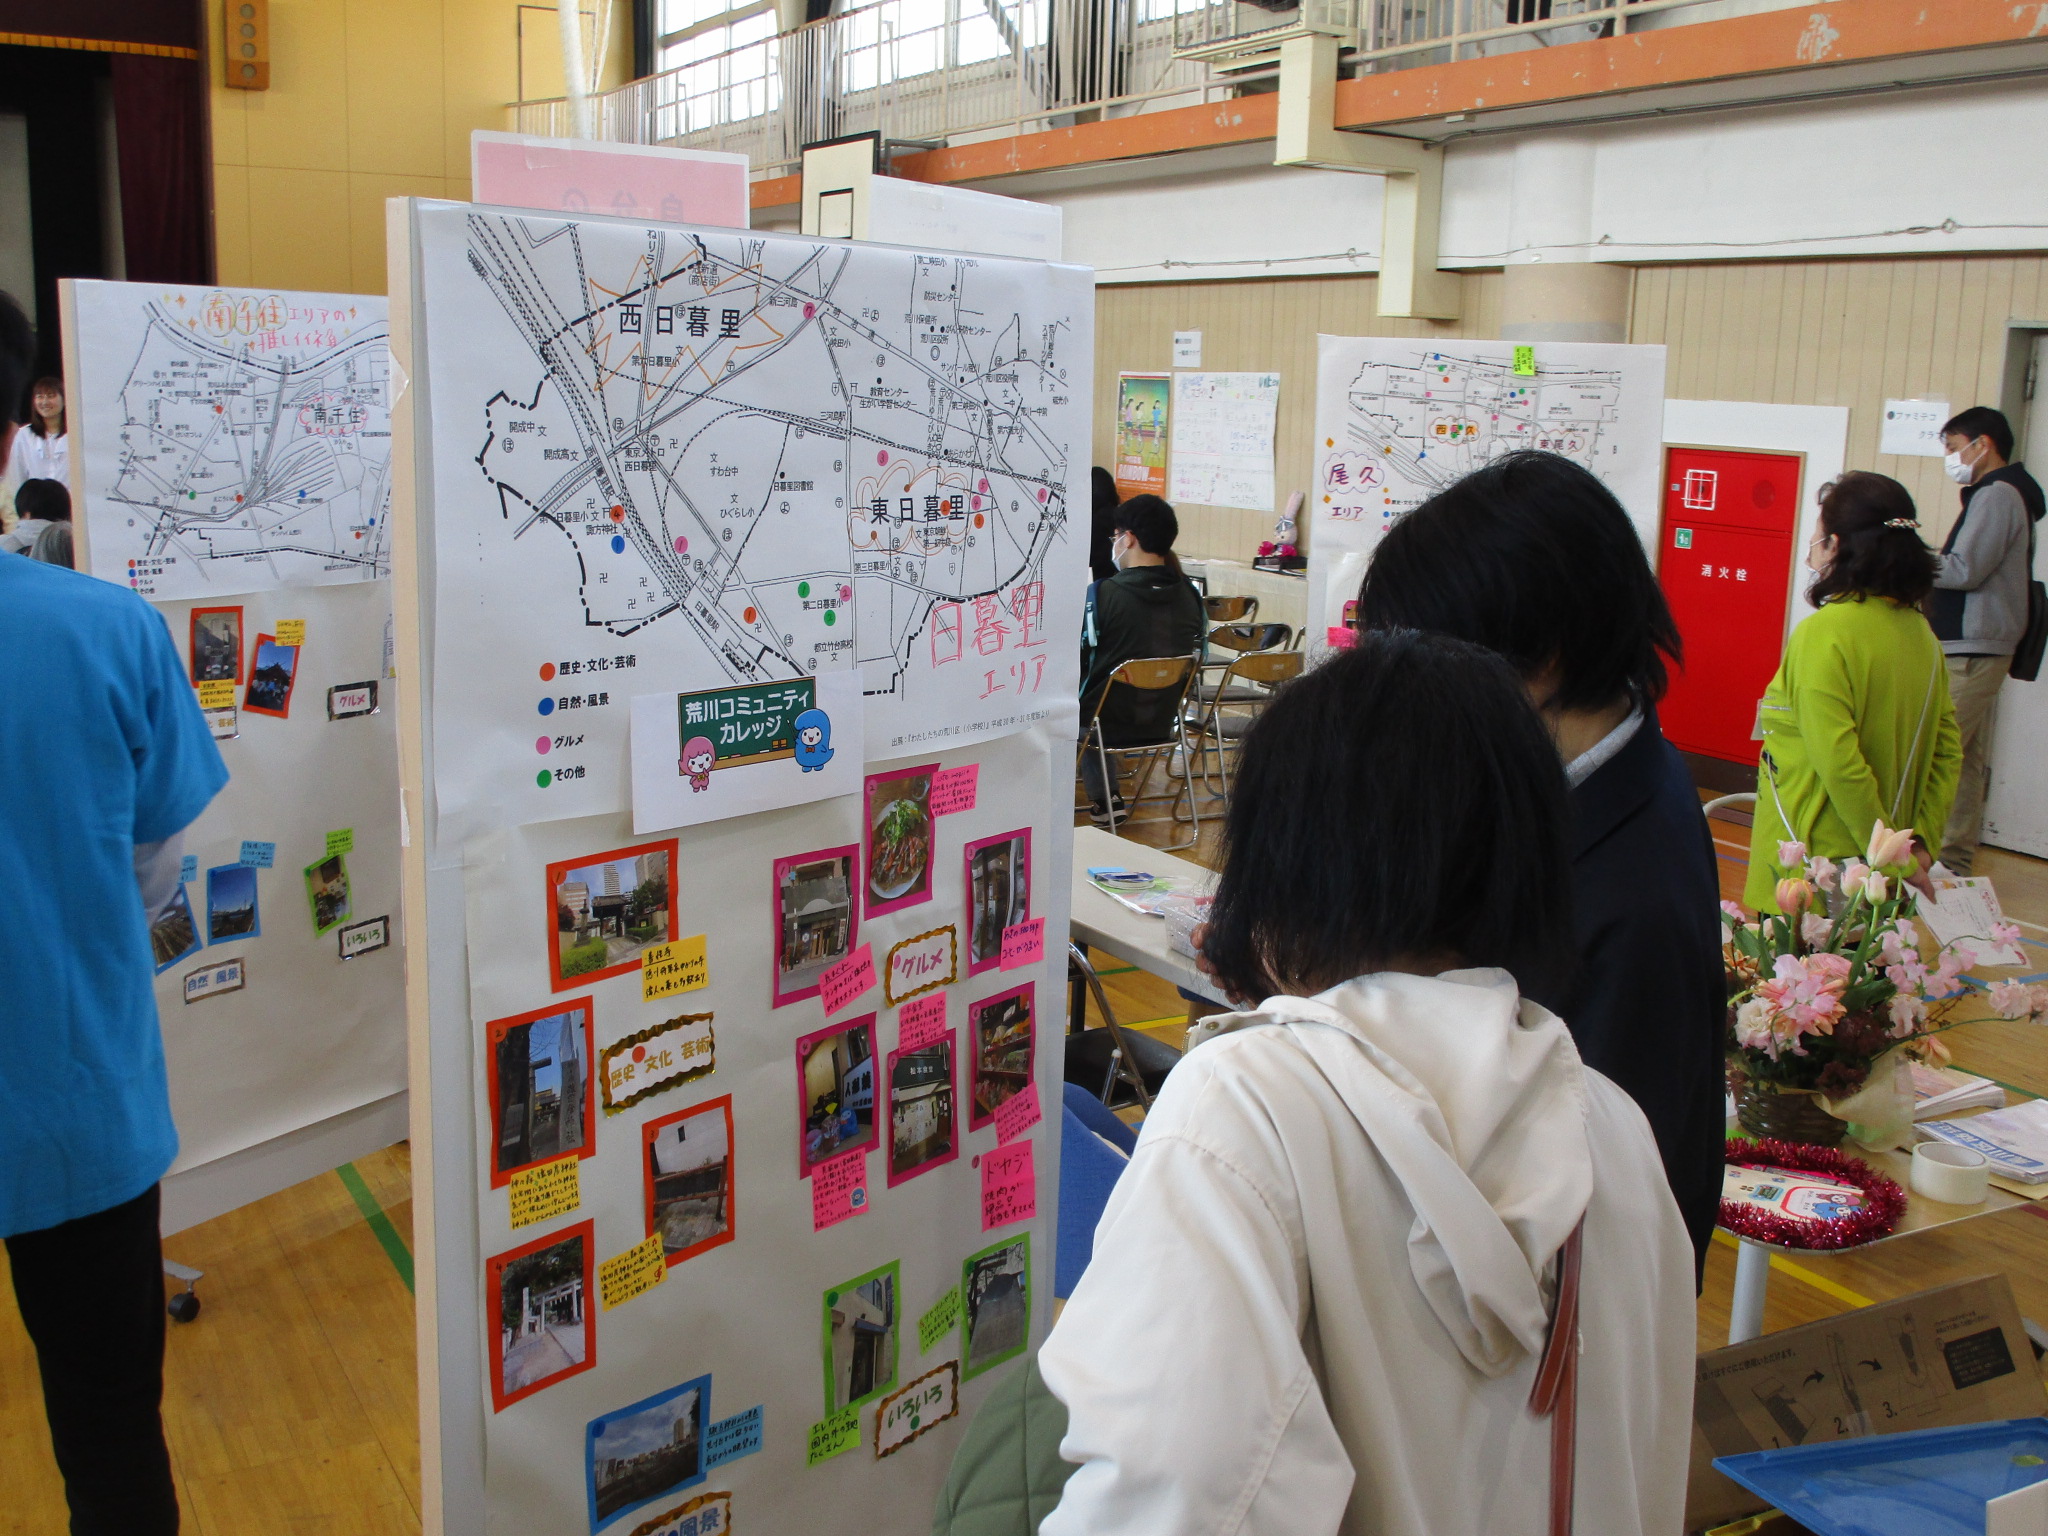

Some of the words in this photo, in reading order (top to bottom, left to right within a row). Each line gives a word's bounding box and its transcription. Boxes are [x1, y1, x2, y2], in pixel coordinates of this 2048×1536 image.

[618, 302, 741, 339] 西日暮里
[920, 334, 949, 346] 荒川区役所
[869, 387, 910, 398] 教育センター
[859, 399, 918, 410] 生がい学習センター
[314, 407, 361, 424] 南千住
[819, 410, 848, 422] 三河島駅
[509, 421, 536, 434] 開成中
[1436, 423, 1478, 436] 西久
[1539, 439, 1580, 452] 東尾久
[543, 448, 571, 461] 開成高
[624, 460, 658, 472] 西日暮里
[709, 466, 739, 478] すわ台中
[1327, 462, 1379, 486] 尾久
[773, 480, 815, 492] 日暮里図書館
[719, 507, 756, 520] ひぐらし小
[870, 493, 966, 525] 東日暮里
[1331, 506, 1365, 520] エリア
[1700, 563, 1748, 582] 消火栓
[802, 598, 845, 611] 第二日暮里小
[694, 600, 721, 634] 日暮里駅
[930, 580, 1048, 669] 日暮里
[559, 655, 637, 676] 歴史・文化・芸術
[978, 653, 1048, 700] エリア
[339, 694, 366, 708] グルメ
[557, 692, 610, 711] 自然・風景
[684, 688, 810, 726] 荒川コミュニティ
[719, 715, 783, 746] カレッジ
[553, 734, 585, 749] グルメ
[553, 765, 586, 781] その他
[346, 929, 383, 948] いろいろ
[901, 947, 945, 979] グルメ
[187, 975, 209, 993] 自然
[216, 967, 240, 985] 風景
[644, 1049, 673, 1074] 文化
[680, 1035, 711, 1061] 芸術
[888, 1383, 944, 1430] いろいろ
